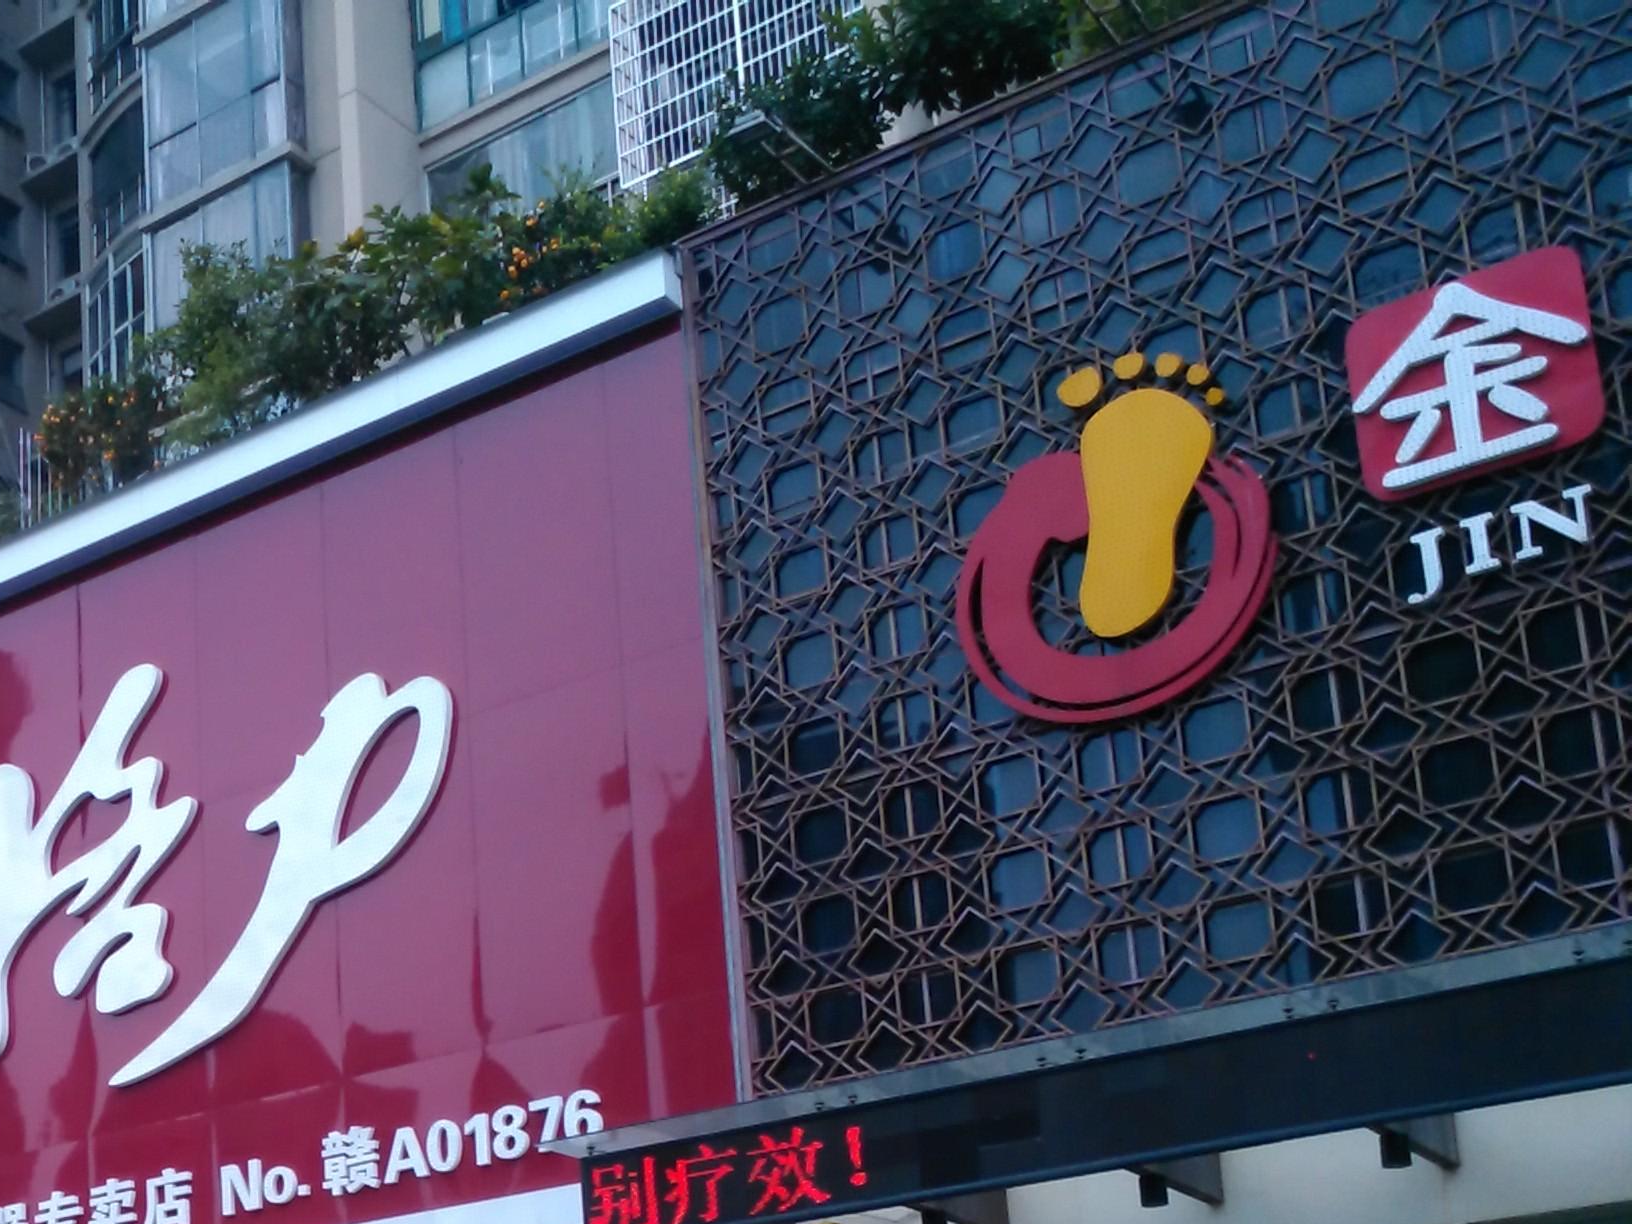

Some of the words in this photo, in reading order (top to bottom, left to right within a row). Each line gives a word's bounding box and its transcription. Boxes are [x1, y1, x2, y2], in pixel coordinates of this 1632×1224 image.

[1352, 281, 1590, 490] 金
[1406, 483, 1594, 605] JIN
[220, 1157, 312, 1218] No.
[321, 1087, 606, 1197] 赣A01876
